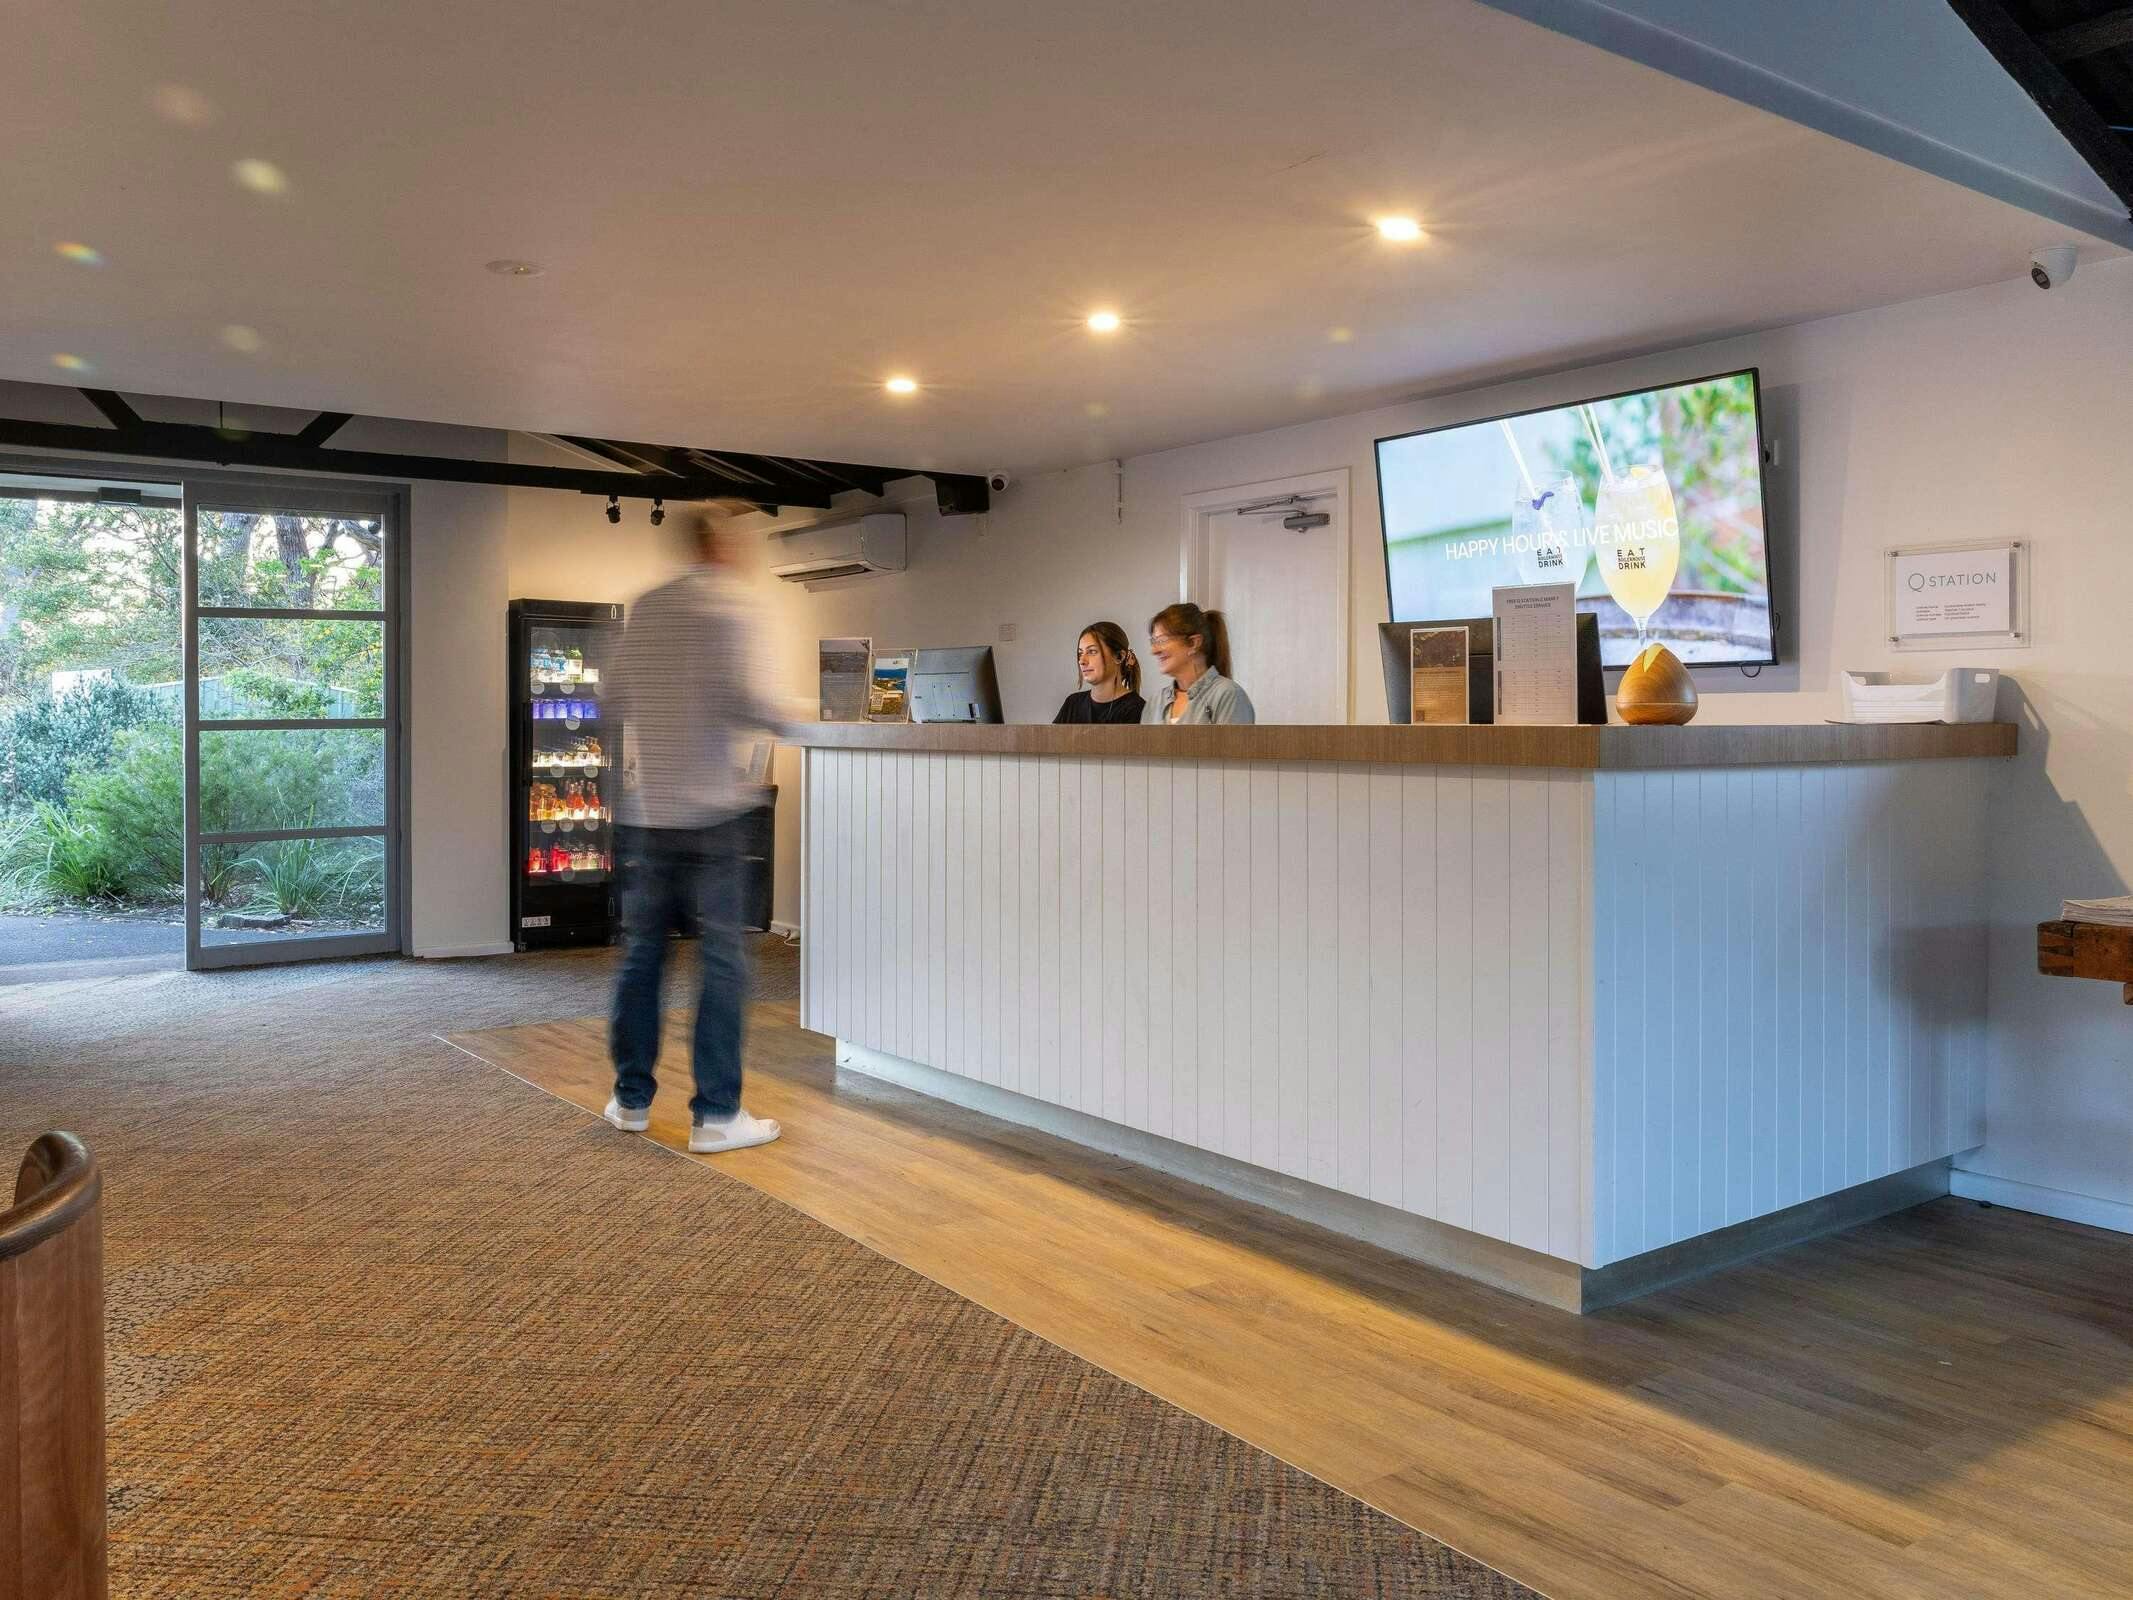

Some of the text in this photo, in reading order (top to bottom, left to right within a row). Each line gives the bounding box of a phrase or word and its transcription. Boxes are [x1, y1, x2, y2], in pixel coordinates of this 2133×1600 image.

[1445, 537, 1499, 560] HAPPY
[1502, 531, 1554, 555] HOUR
[1573, 524, 1610, 547] LIVE
[1614, 518, 1679, 542] MUSIC
[1538, 559, 1564, 568] DRINK
[1618, 561, 1647, 570] DRINK
[1929, 572, 1997, 587] STATION
